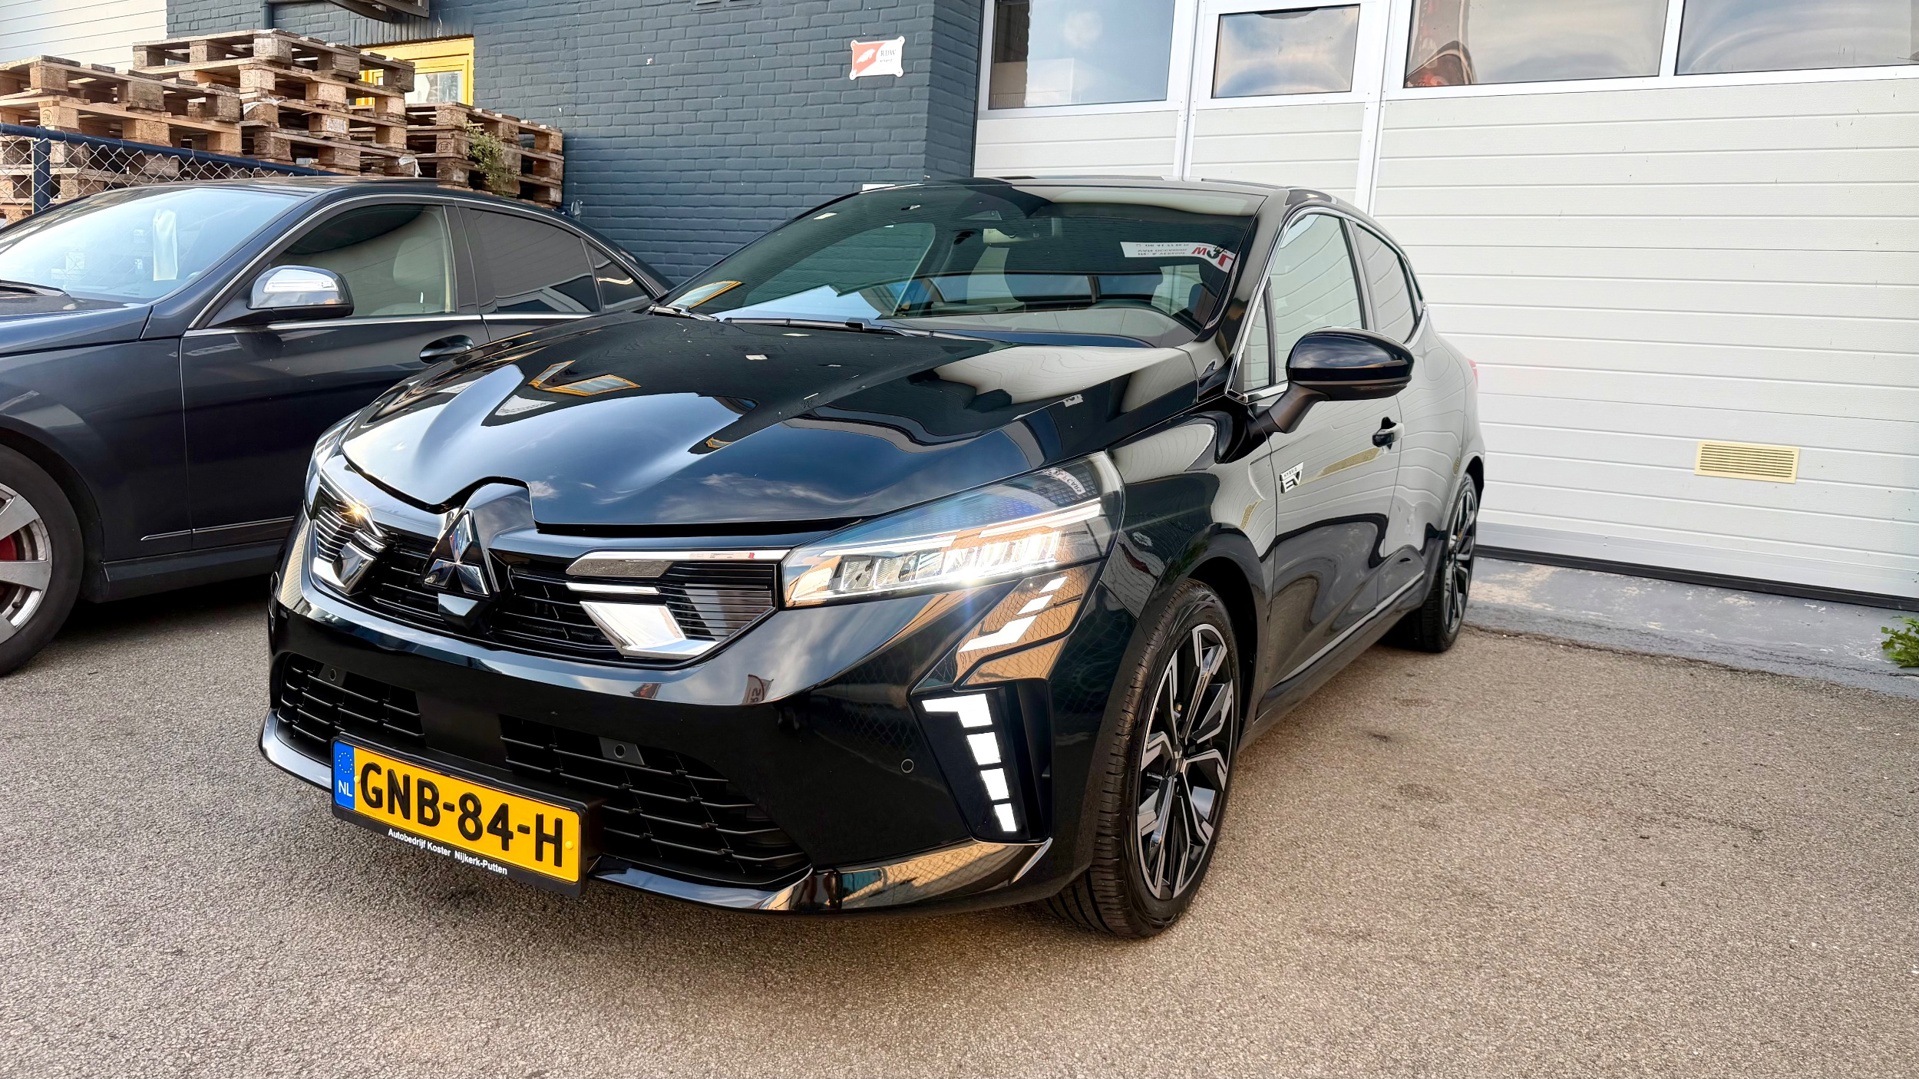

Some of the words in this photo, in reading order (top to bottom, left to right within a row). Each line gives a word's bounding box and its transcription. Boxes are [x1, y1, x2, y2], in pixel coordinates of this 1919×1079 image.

[338, 780, 353, 797] NL
[361, 762, 563, 868] GNB-84-H
[388, 828, 426, 850] Autobedrijf
[427, 842, 451, 857] Koster
[454, 850, 508, 875] Nijkerk-Putten
